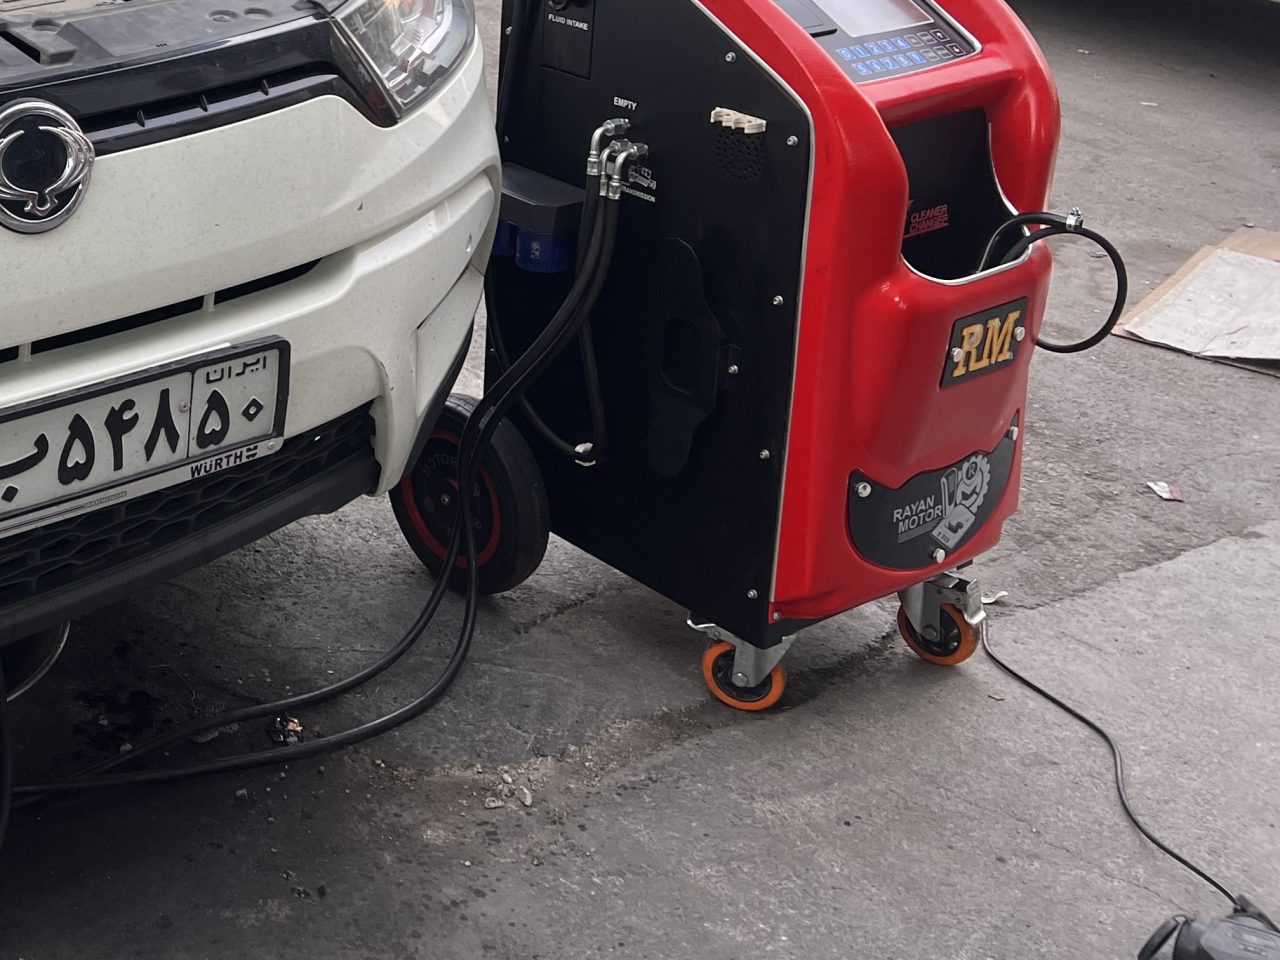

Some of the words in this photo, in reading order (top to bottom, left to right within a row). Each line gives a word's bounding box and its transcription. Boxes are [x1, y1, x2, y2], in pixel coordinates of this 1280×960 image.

[548, 13, 566, 24] FLUID
[566, 19, 589, 31] INTAKE
[613, 96, 637, 111] EMPTY
[951, 310, 1021, 378] RM
[204, 353, 268, 385] ایران
[893, 495, 935, 523] RAYAN
[898, 505, 942, 534] MOTOR
